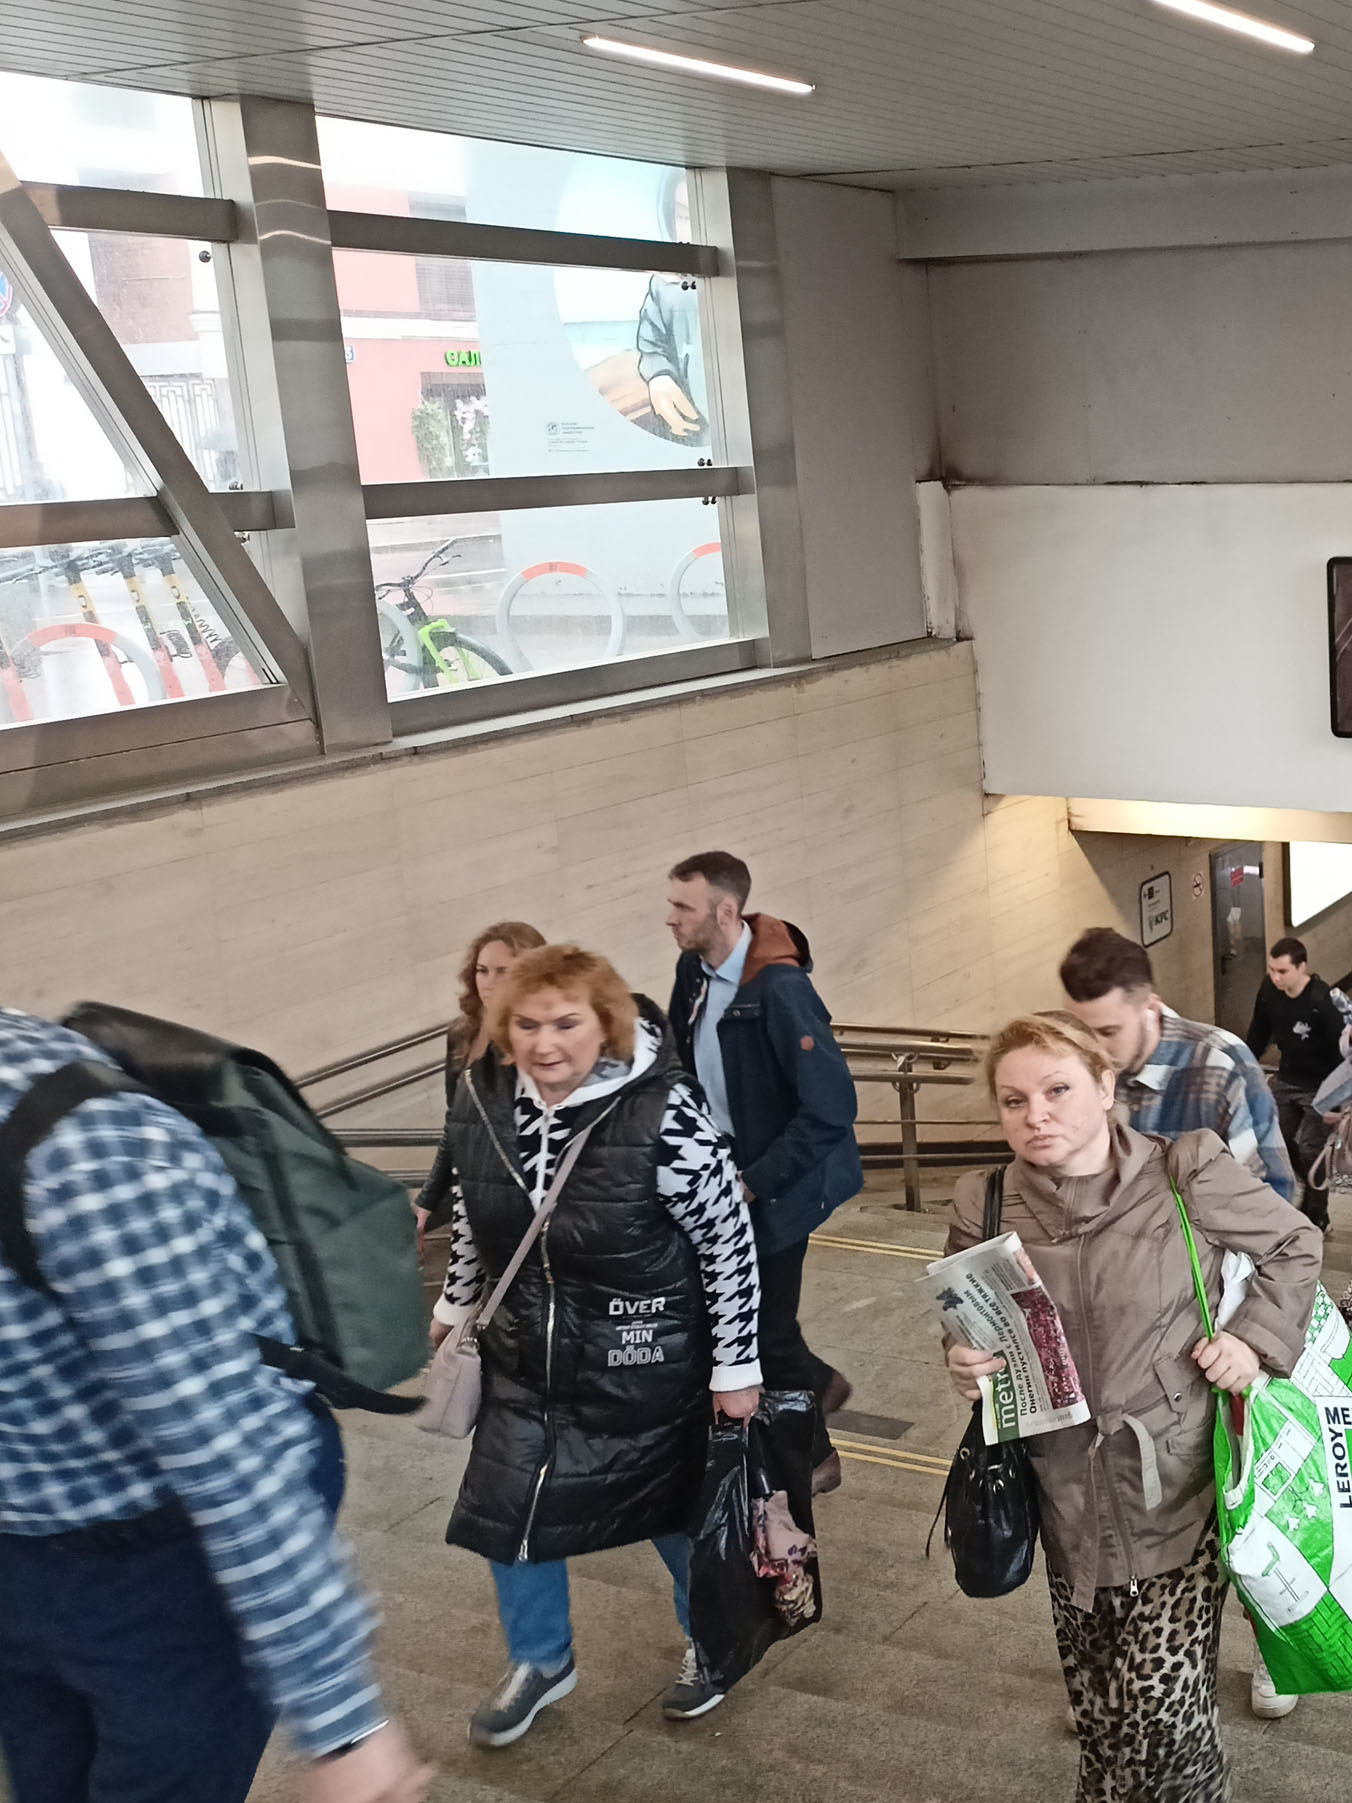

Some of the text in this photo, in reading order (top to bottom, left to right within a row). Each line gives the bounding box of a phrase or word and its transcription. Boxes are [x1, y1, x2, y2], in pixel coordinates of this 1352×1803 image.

[609, 1296, 666, 1316] ÖVER
[963, 1290, 1009, 1343] Лермонтовым
[1000, 1316, 1010, 1328] во
[622, 1329, 653, 1345] MIN
[1007, 1328, 1028, 1374] пустился
[607, 1344, 665, 1367] DÖDA
[1009, 1350, 1023, 1382] дуэли
[1018, 1383, 1028, 1417] После
[1025, 1374, 1038, 1414] Онегин
